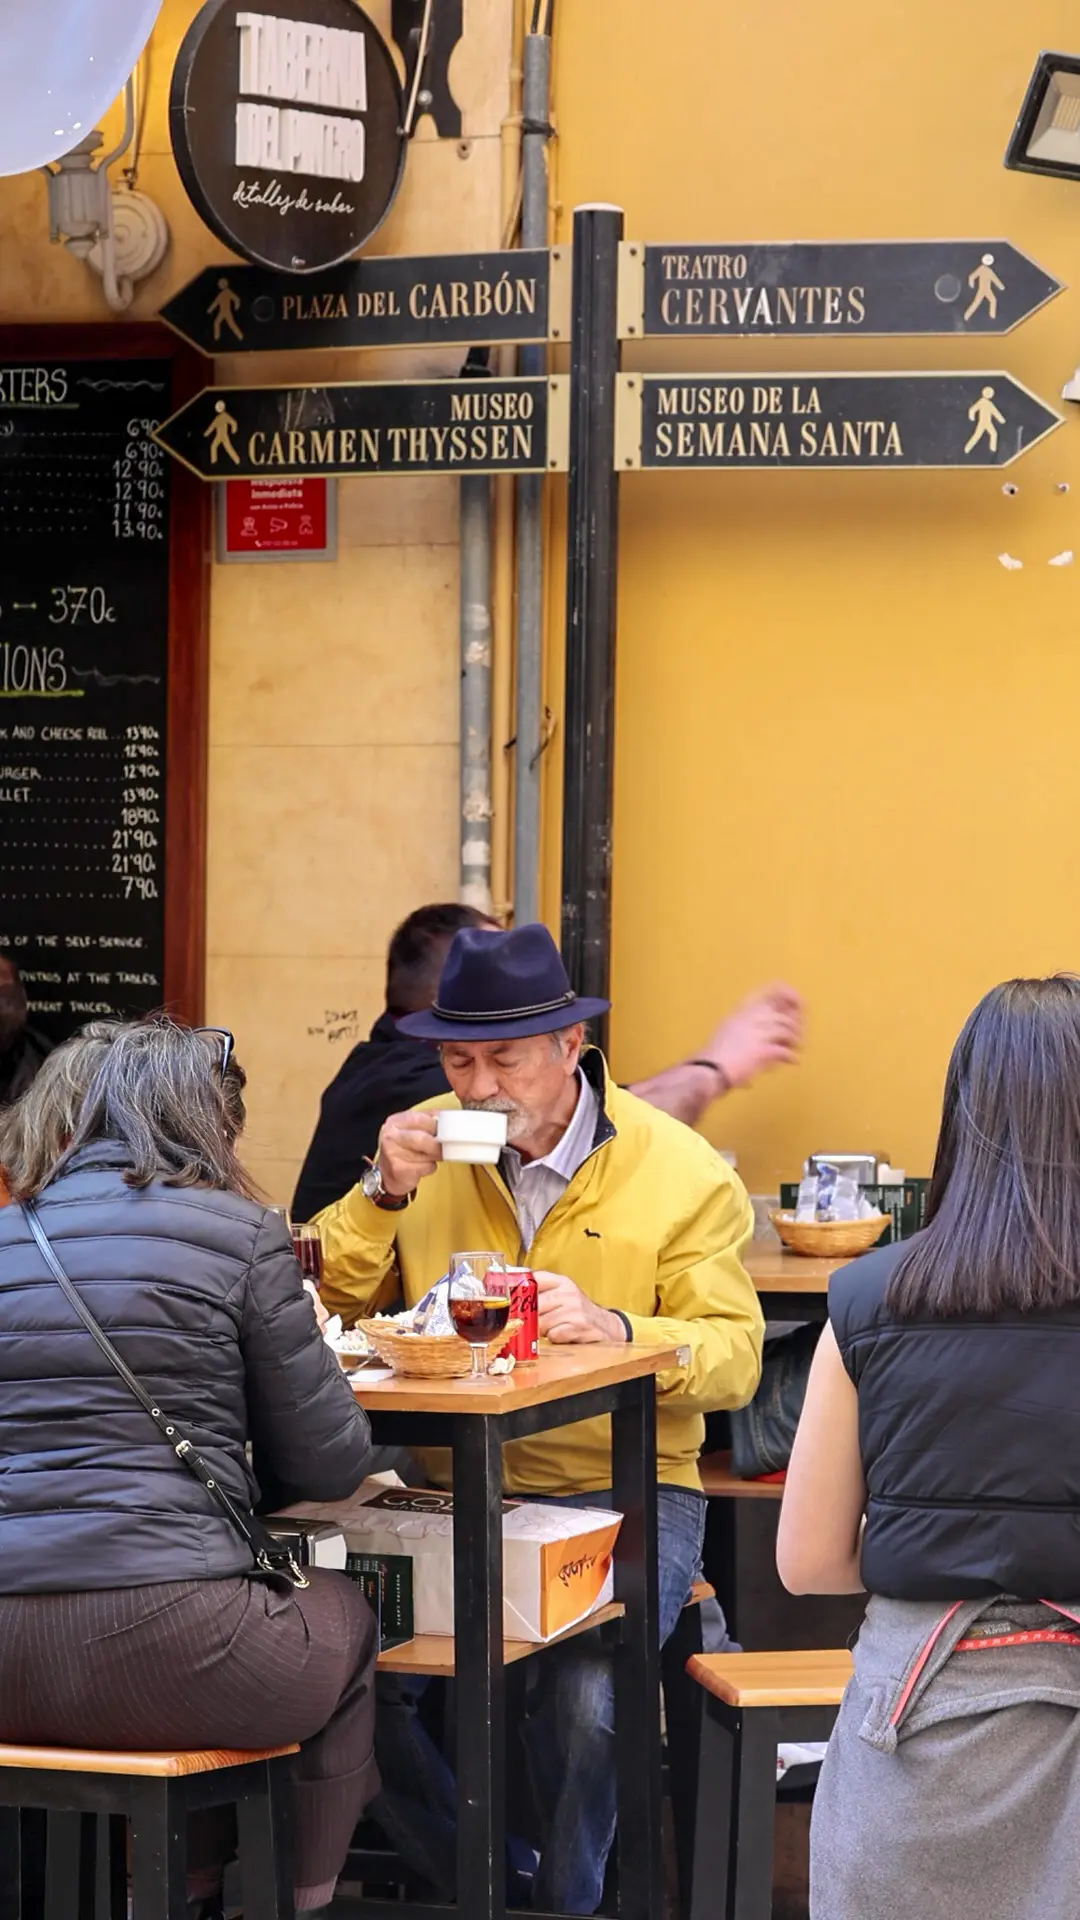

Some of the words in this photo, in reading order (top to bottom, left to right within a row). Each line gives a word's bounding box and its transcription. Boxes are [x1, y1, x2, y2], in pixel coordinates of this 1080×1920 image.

[662, 254, 748, 280] TEATRO
[282, 293, 349, 320] PLAZA
[357, 291, 400, 318] DEL
[409, 271, 537, 319] CARBÓN
[660, 286, 866, 326] CERVANTES
[451, 392, 534, 422] MUSEO
[657, 386, 745, 416] MUSEO
[752, 386, 783, 415] DE
[792, 386, 822, 415] LA
[248, 429, 381, 466] CARMEN
[387, 424, 534, 463] THYSSEN
[655, 421, 791, 458] SEMANA
[800, 420, 904, 457] SANTA
[0, 642, 67, 692] IONS
[12, 725, 35, 740] AND
[41, 725, 83, 741] CHEESE
[14, 935, 28, 947] OF
[36, 935, 58, 948] THE
[66, 971, 82, 984] AT
[87, 971, 112, 985] THE
